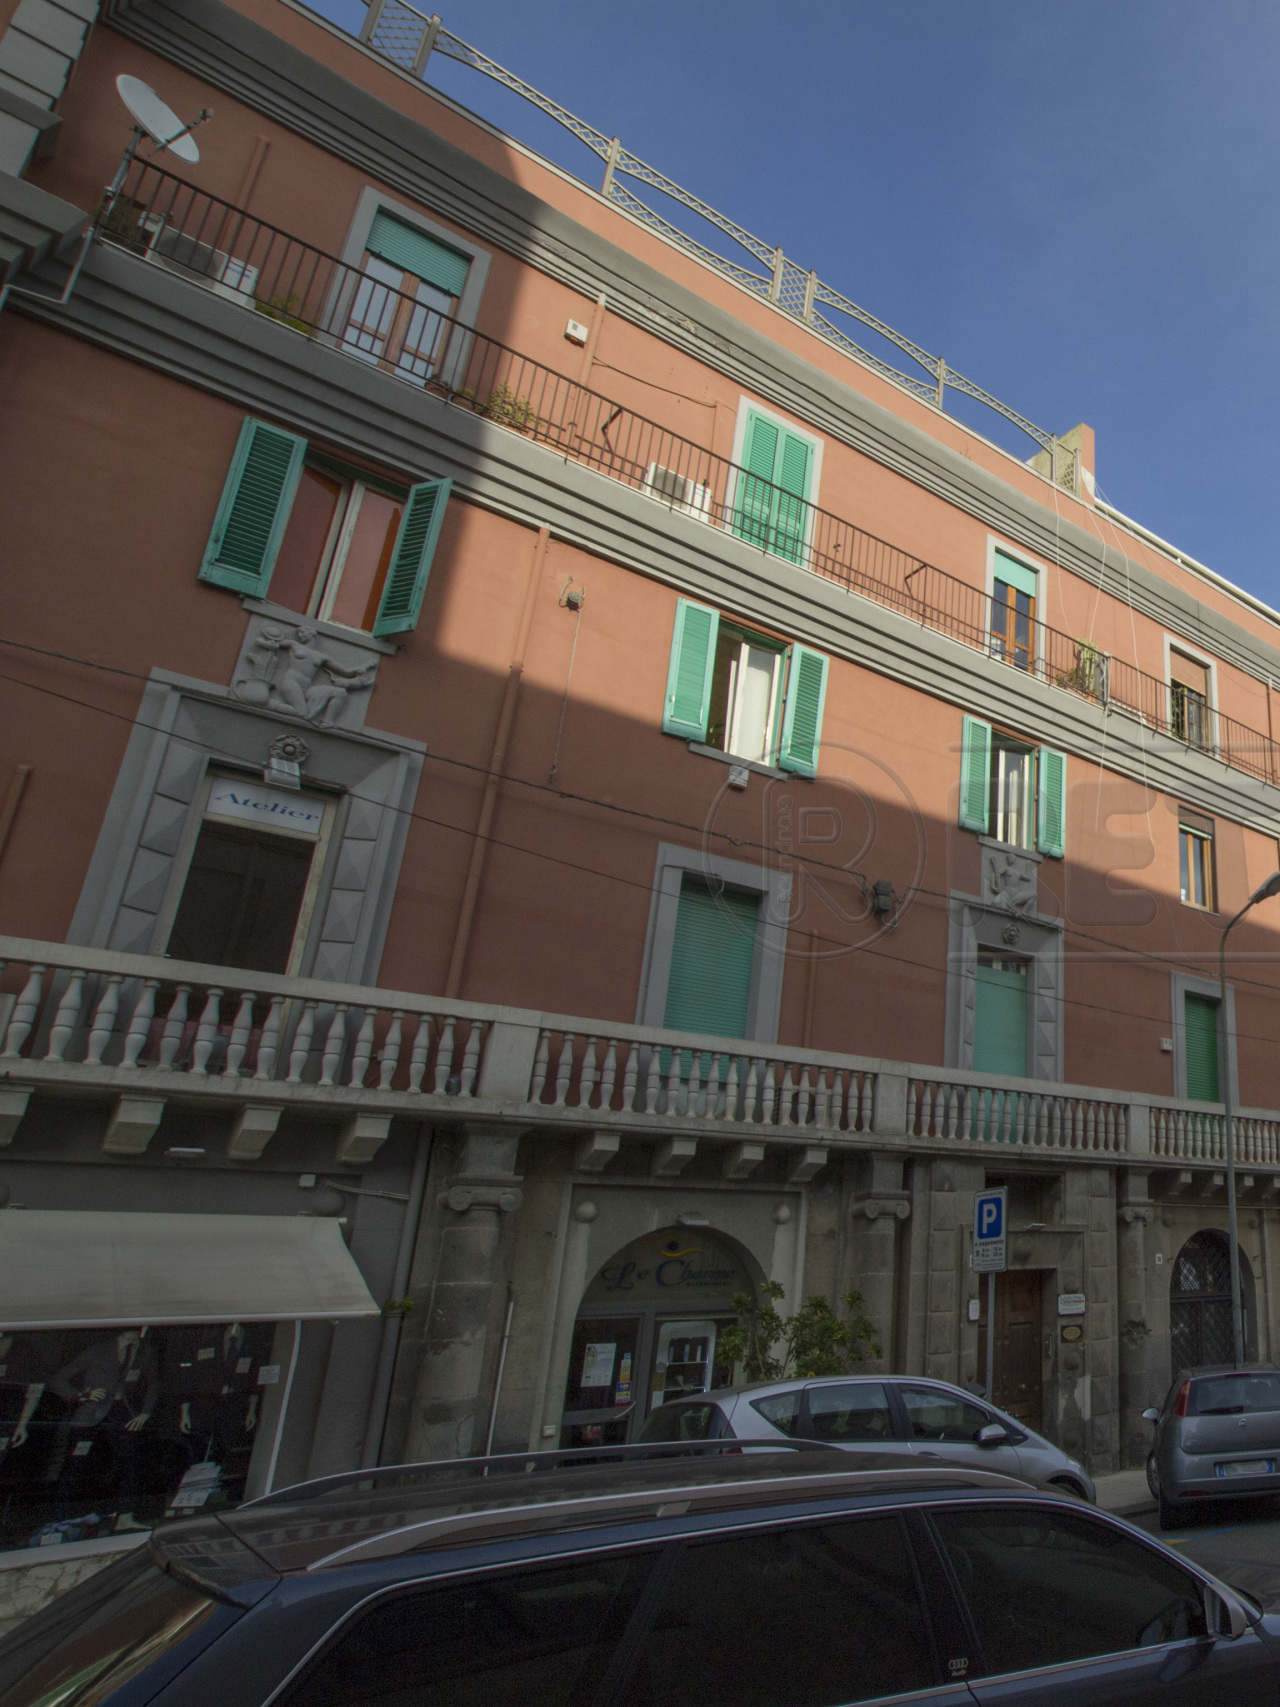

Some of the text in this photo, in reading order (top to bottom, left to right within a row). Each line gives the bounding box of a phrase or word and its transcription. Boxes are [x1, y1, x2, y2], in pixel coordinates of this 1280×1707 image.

[213, 792, 320, 822] Atelier
[982, 1203, 997, 1234] P
[601, 1262, 649, 1291] Le
